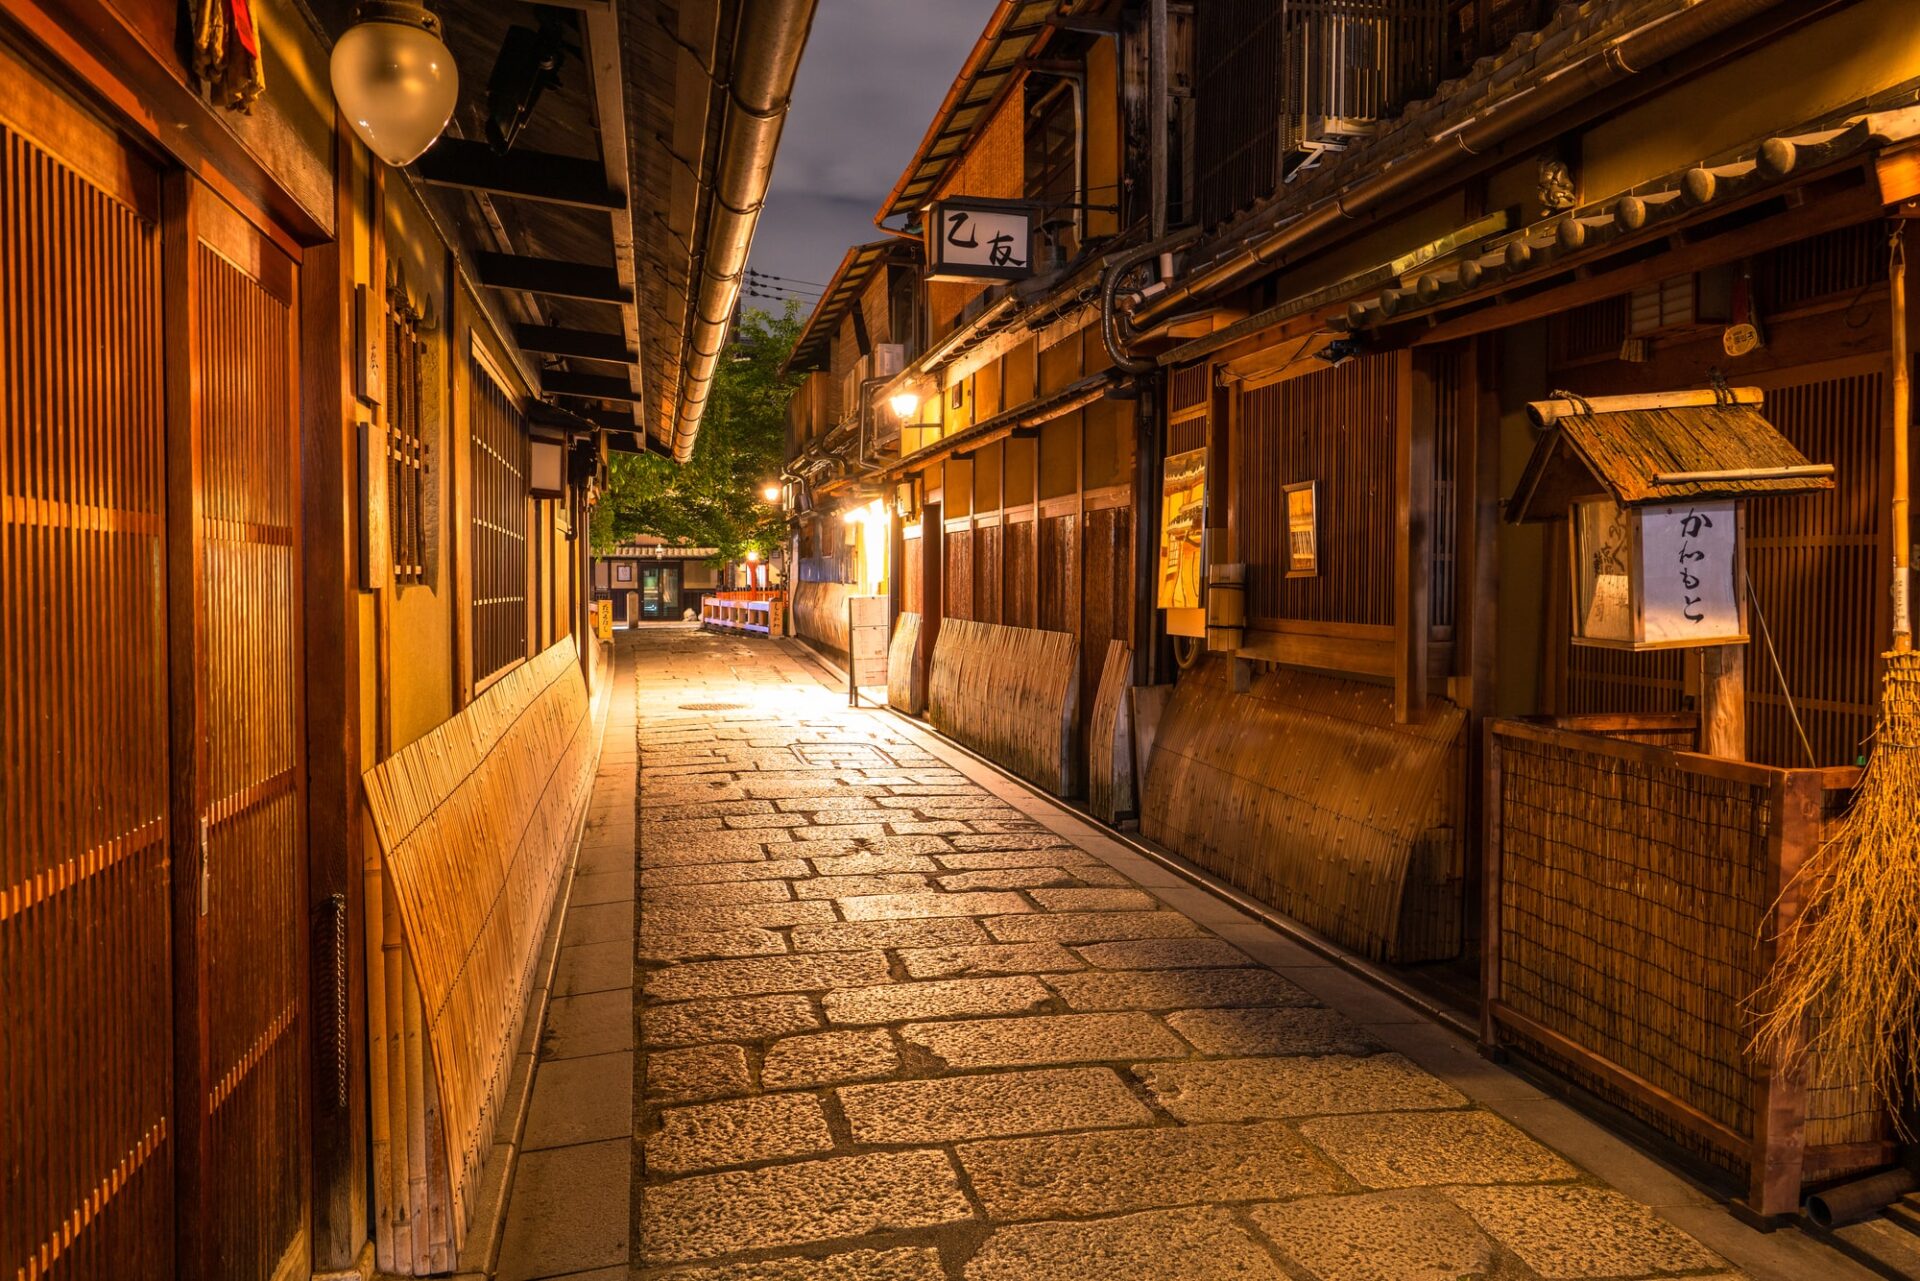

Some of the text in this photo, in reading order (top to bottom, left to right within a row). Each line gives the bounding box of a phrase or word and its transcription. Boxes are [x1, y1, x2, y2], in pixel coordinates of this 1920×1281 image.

[948, 212, 1026, 267] 乙友
[1679, 507, 1713, 624] かわもと
